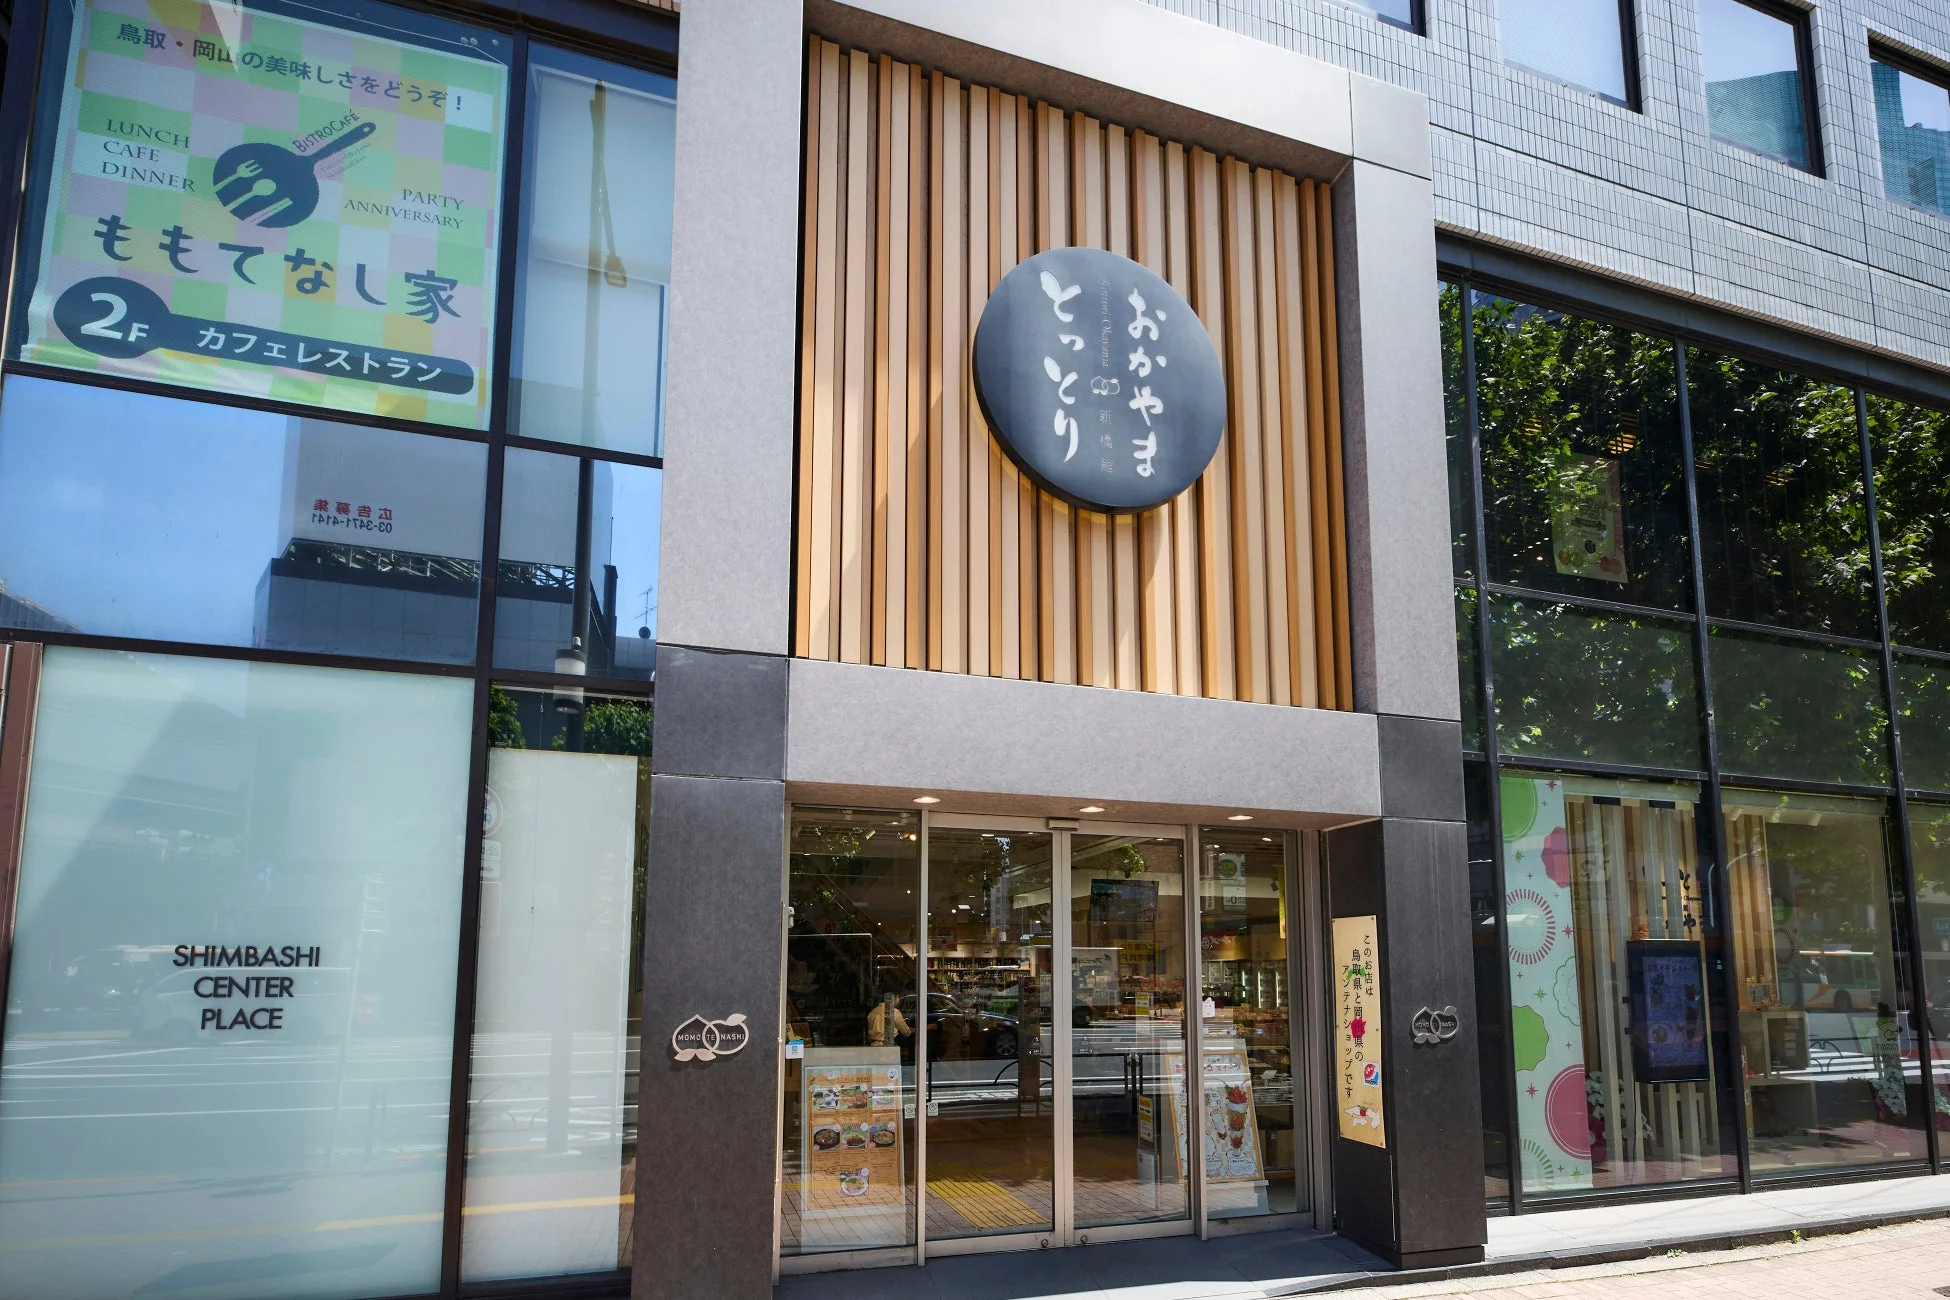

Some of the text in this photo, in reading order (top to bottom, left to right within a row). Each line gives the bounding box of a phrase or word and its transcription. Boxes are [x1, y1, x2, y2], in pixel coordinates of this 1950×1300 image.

[103, 140, 160, 162] CAFE
[105, 118, 190, 148] LUNCH
[102, 161, 195, 192] DINNER
[344, 199, 463, 229] ANNIVERSARY
[402, 188, 464, 211] PARTY
[93, 214, 461, 324] ももてなし家
[80, 292, 149, 342] 2F
[197, 326, 443, 382] カフェレストラン
[1040, 270, 1085, 463] とっとり
[1128, 287, 1167, 477] おかやま
[173, 944, 321, 967] SHIMBASHI
[1363, 934, 1374, 996] このお店は
[193, 976, 294, 998] CENTER
[1352, 948, 1364, 1062] 鳥取県と岡山県の
[201, 1008, 283, 1030] PLACE
[1342, 964, 1353, 1099] アンテナショップです
